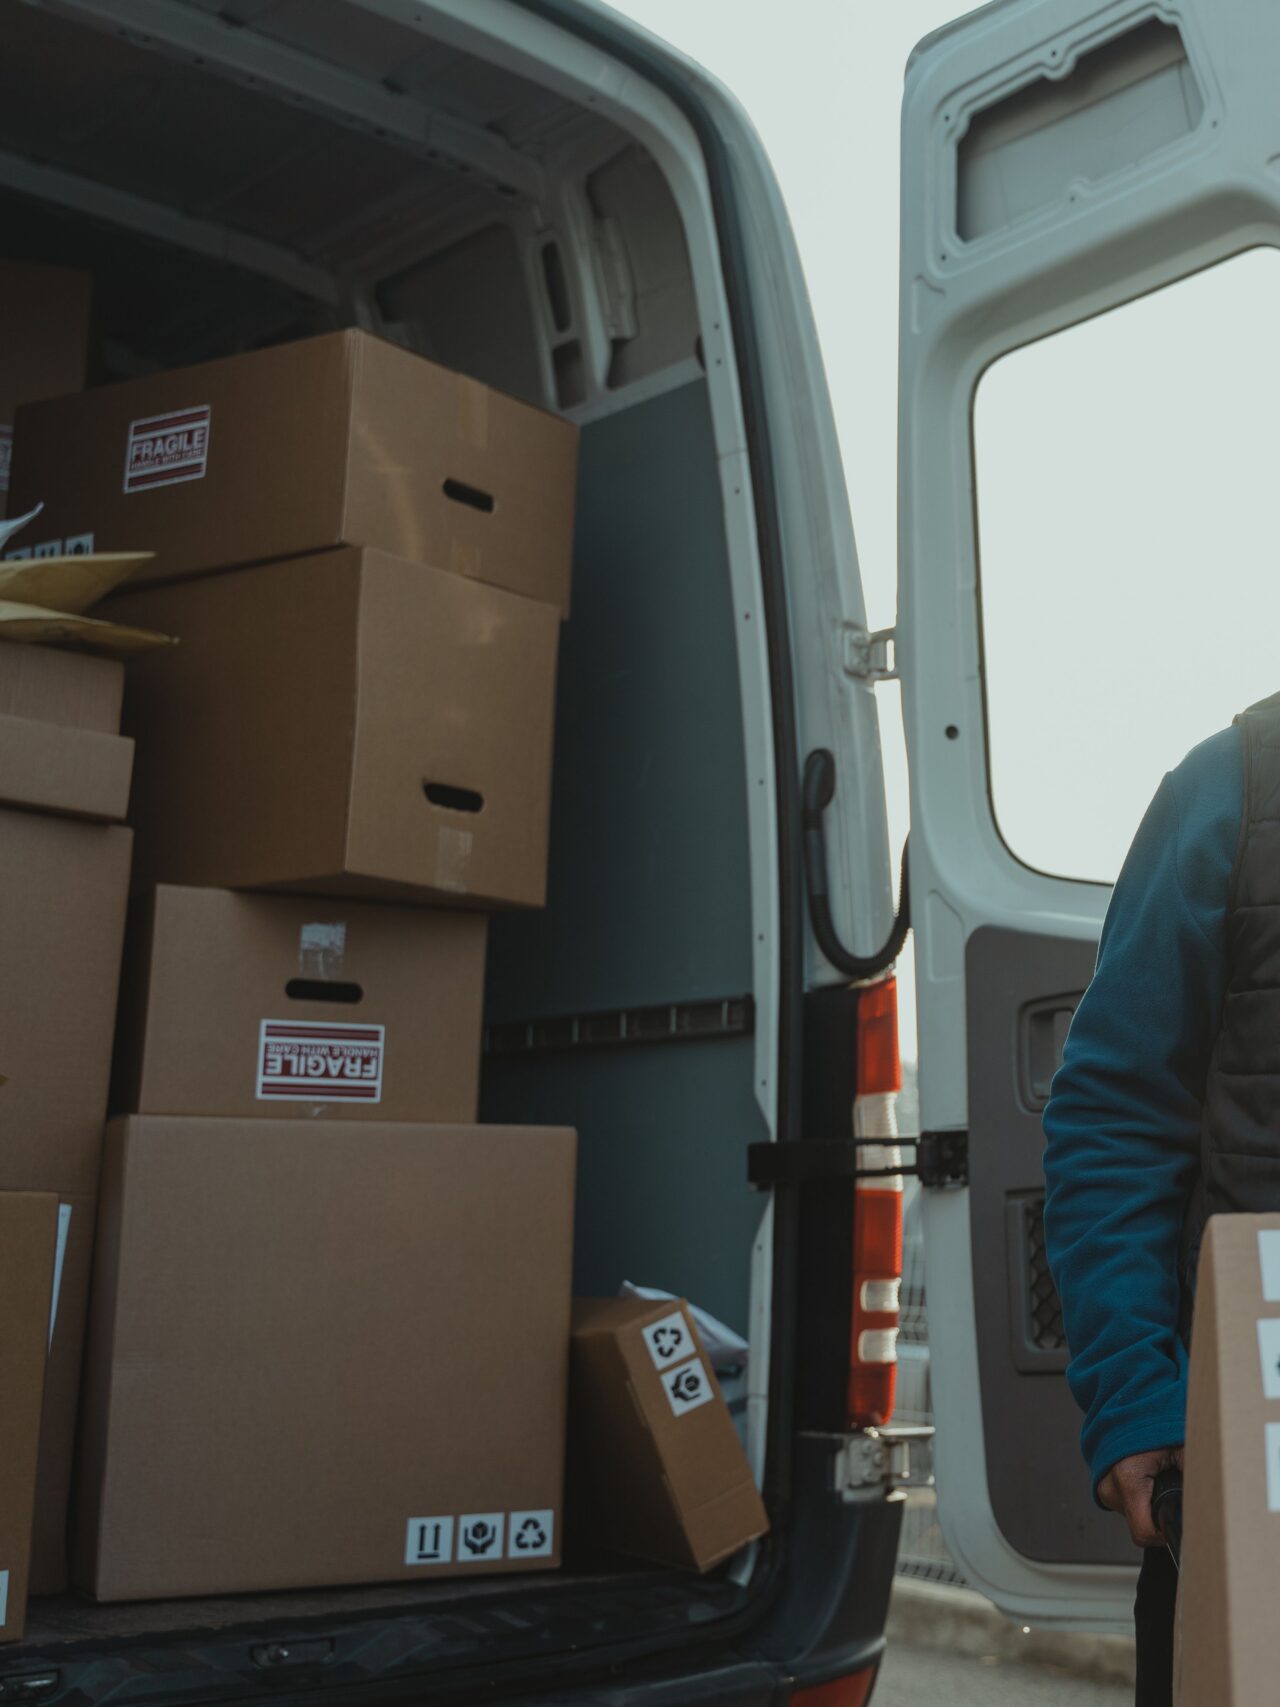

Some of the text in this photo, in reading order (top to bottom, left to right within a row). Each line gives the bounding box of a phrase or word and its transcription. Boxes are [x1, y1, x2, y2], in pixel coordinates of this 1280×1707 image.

[132, 429, 205, 463] FRAGILE
[267, 1044, 378, 1056] HANDLE WITH CARE
[266, 1055, 377, 1077] FRAGILE
